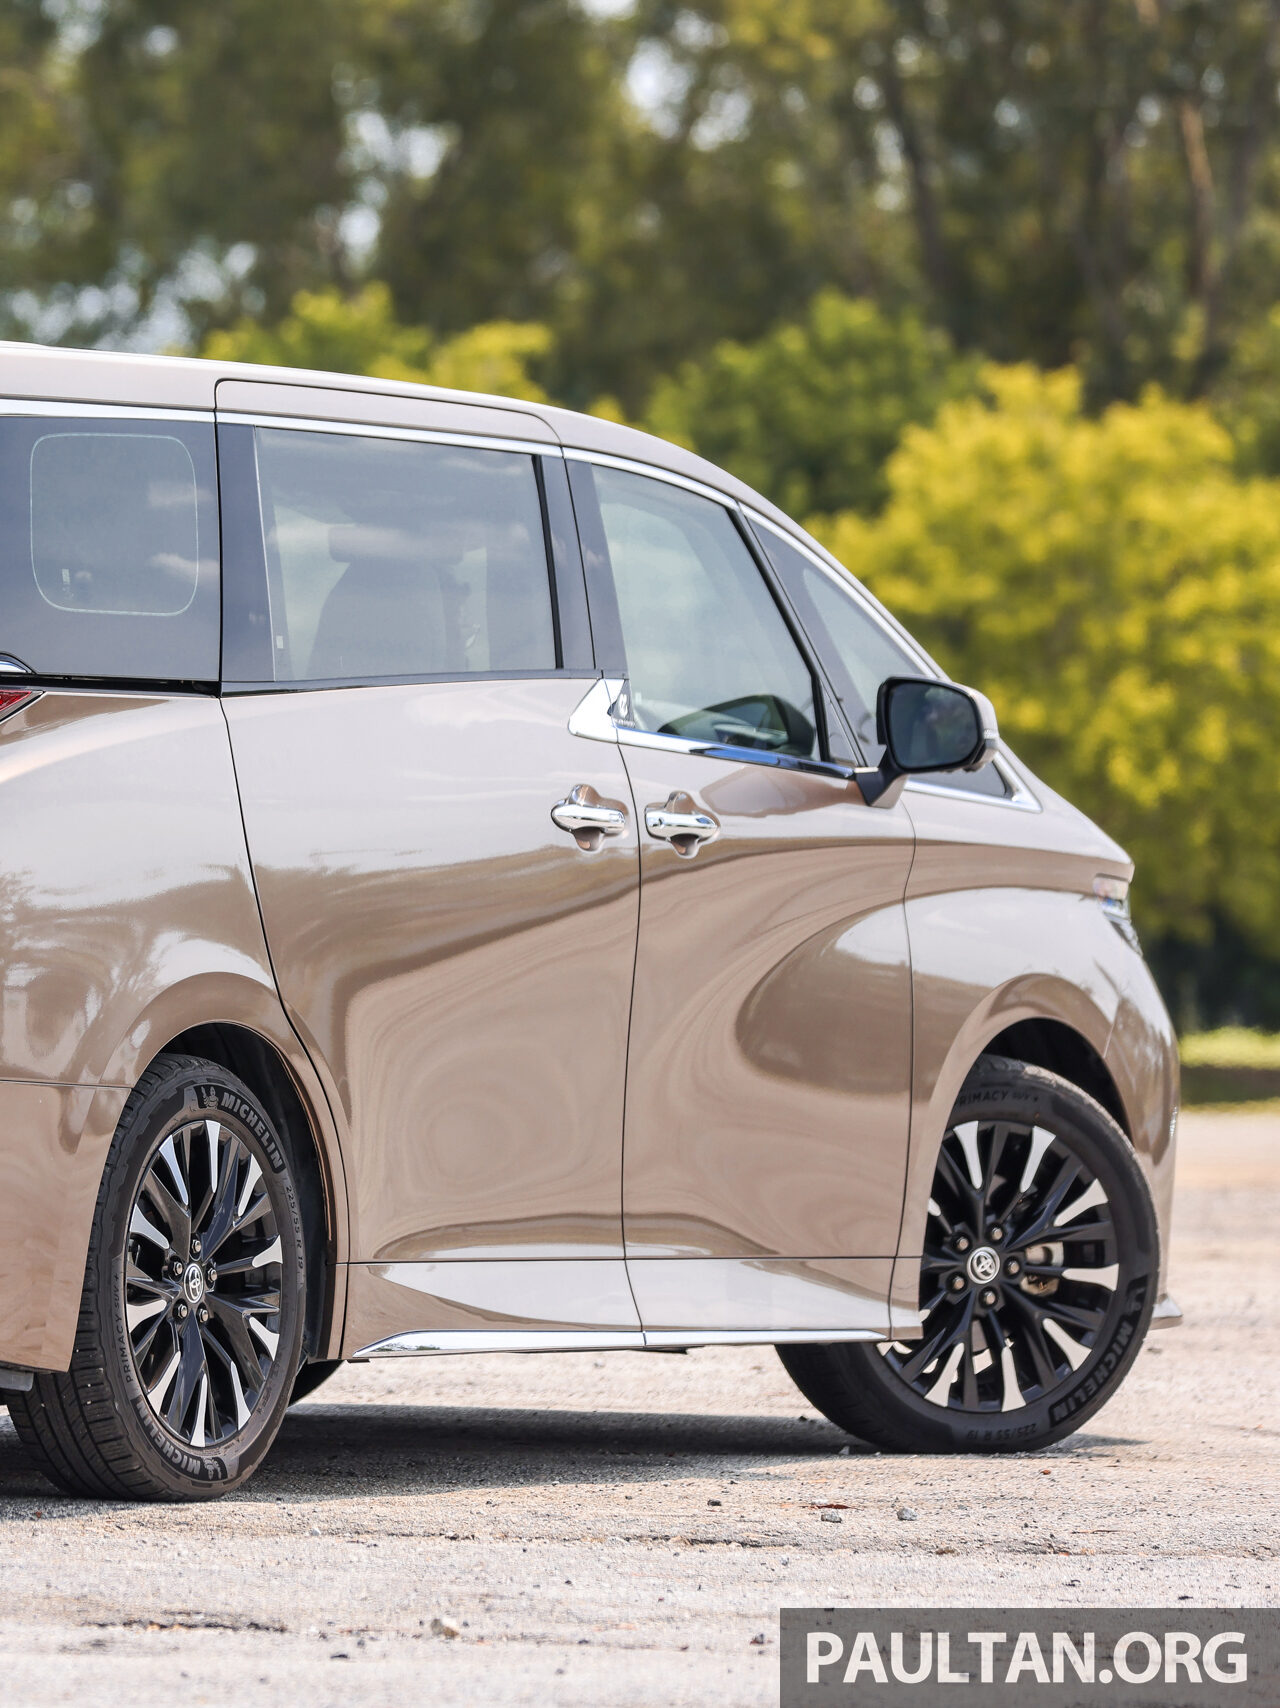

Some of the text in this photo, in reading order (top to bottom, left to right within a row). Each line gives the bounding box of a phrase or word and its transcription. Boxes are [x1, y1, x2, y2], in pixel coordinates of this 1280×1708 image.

[221, 1091, 284, 1170] MICHELIN
[285, 1185, 300, 1234] 225/55
[115, 1314, 134, 1384] PRIMACY
[1052, 1320, 1134, 1421] MICHELIN
[136, 1401, 201, 1475] MICHELIN
